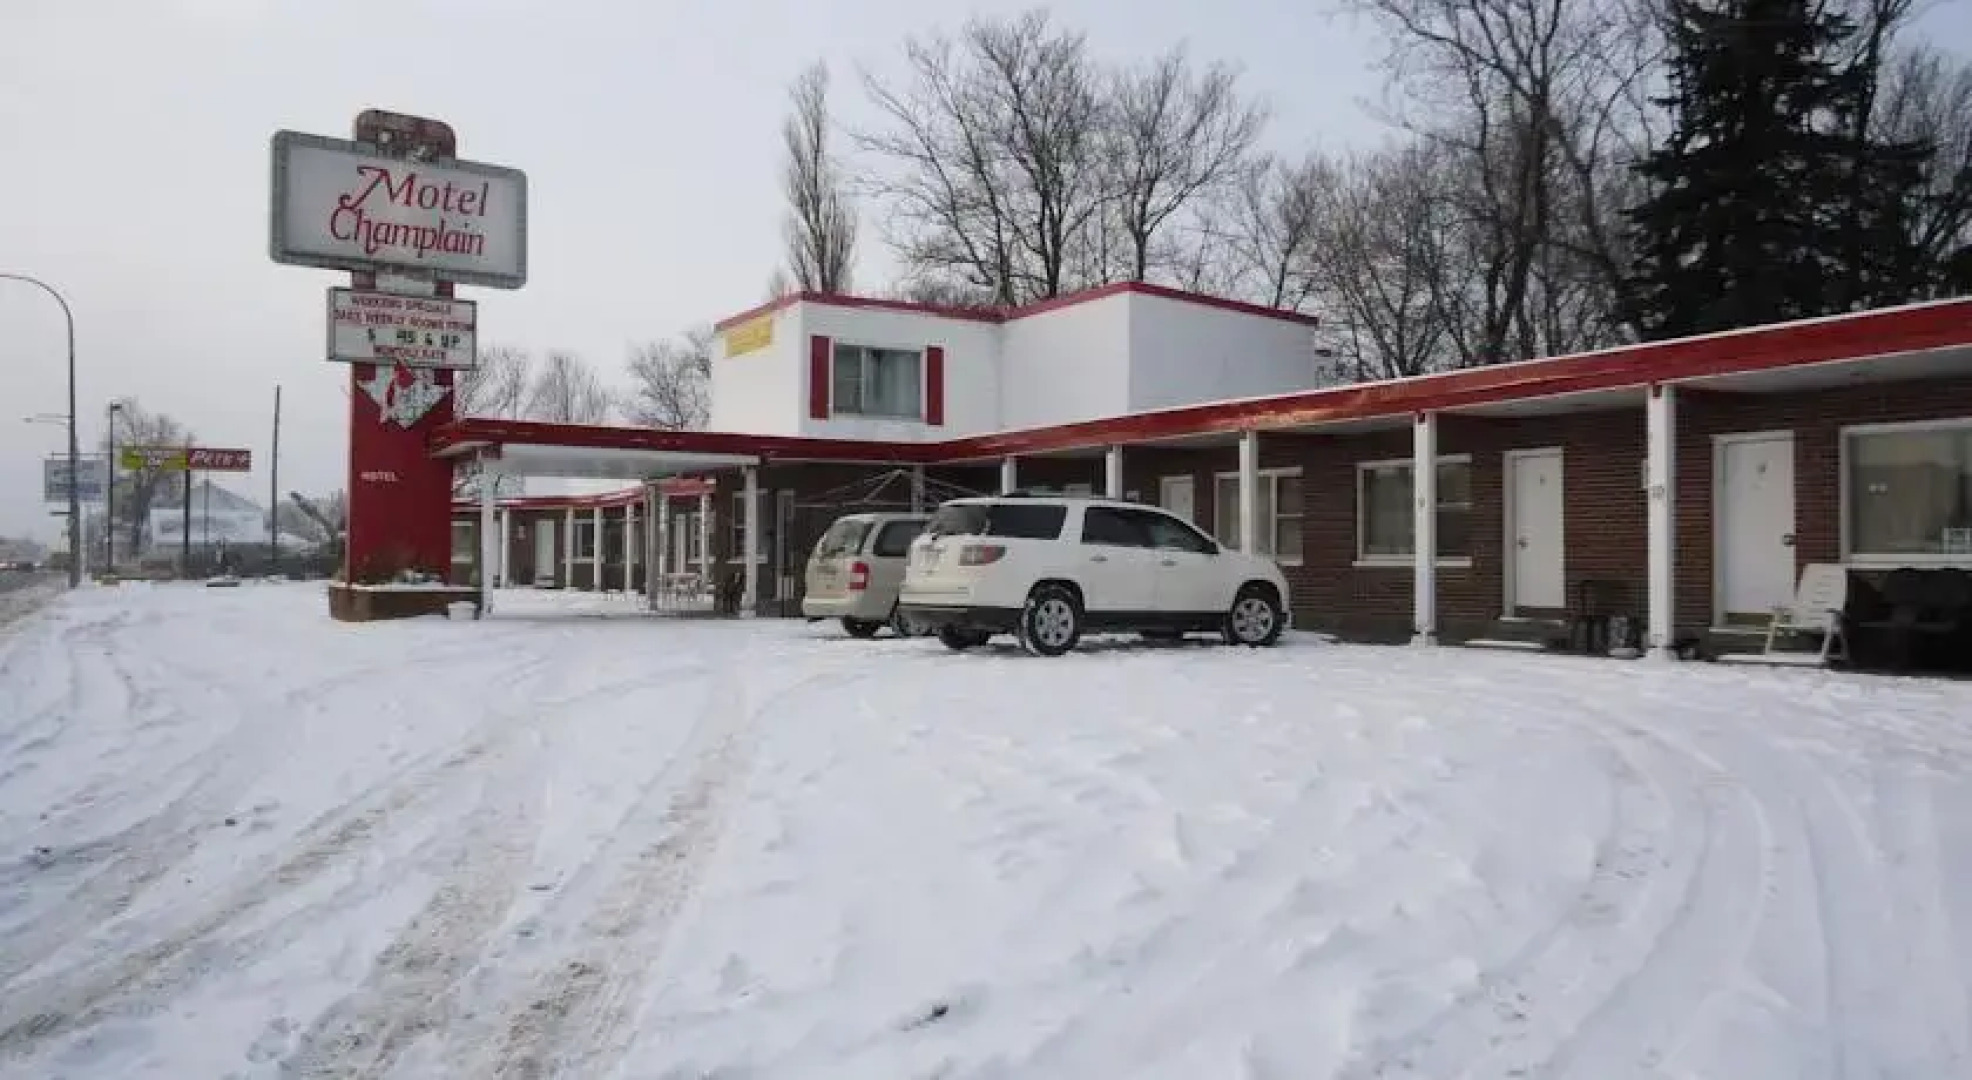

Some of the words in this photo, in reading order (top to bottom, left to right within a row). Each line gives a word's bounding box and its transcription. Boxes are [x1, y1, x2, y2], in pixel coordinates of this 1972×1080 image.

[338, 165, 490, 217] Motel
[330, 207, 485, 259] Champlain
[441, 334, 461, 348] UP
